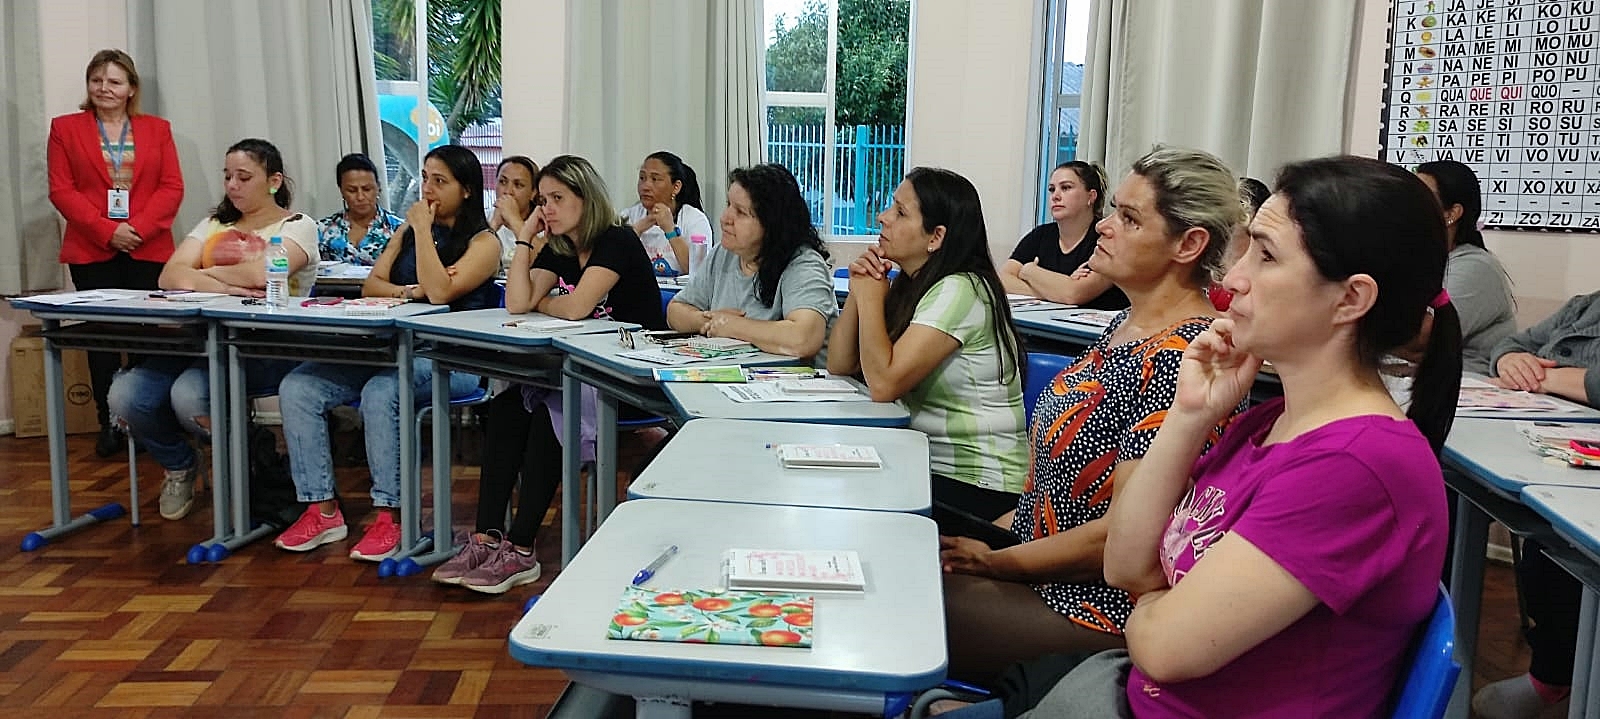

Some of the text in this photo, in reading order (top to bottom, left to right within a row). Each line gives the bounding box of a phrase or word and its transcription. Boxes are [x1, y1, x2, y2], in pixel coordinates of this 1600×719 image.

[1406, 1, 1415, 15] J
[1447, 0, 1466, 13] JA
[1407, 1, 1594, 30] K KA KE KI KO KU
[1406, 17, 1590, 45] L LA LE LI LO LU
[1405, 34, 1592, 59] M MA ME MI MO MU
[1403, 50, 1589, 74] N NA NE NI NO NU
[1403, 67, 1587, 89] P PA PE PI PO PU
[1401, 85, 1557, 105] Q QUA QUE QUI QUO
[1400, 106, 1409, 118] R
[1439, 104, 1459, 117] RA
[1469, 103, 1488, 116] RE
[1500, 102, 1514, 115] RI
[1530, 101, 1553, 114] RO
[1562, 100, 1585, 113] RU
[1398, 119, 1406, 132] S
[1438, 120, 1457, 132] SA
[1467, 119, 1487, 131] SE
[1498, 118, 1512, 130] SI
[1529, 117, 1551, 130] SO
[1560, 116, 1582, 129] SU
[1398, 136, 1406, 148] T
[1437, 135, 1454, 147] TA
[1466, 134, 1485, 146] TE
[1497, 134, 1510, 146] TI
[1528, 133, 1548, 146] TO
[1559, 132, 1580, 145] TU
[1396, 150, 1405, 162] V
[1436, 150, 1454, 161] VA
[1465, 150, 1484, 162] VE
[1496, 149, 1509, 162] VI
[1526, 149, 1548, 162] VO
[1558, 149, 1579, 162] VU
[1493, 180, 1507, 193] XI
[1522, 180, 1545, 193] XO
[1554, 181, 1576, 194] XU
[1489, 212, 1503, 224] ZI
[1518, 213, 1541, 225] ZO
[1549, 214, 1572, 226] ZU
